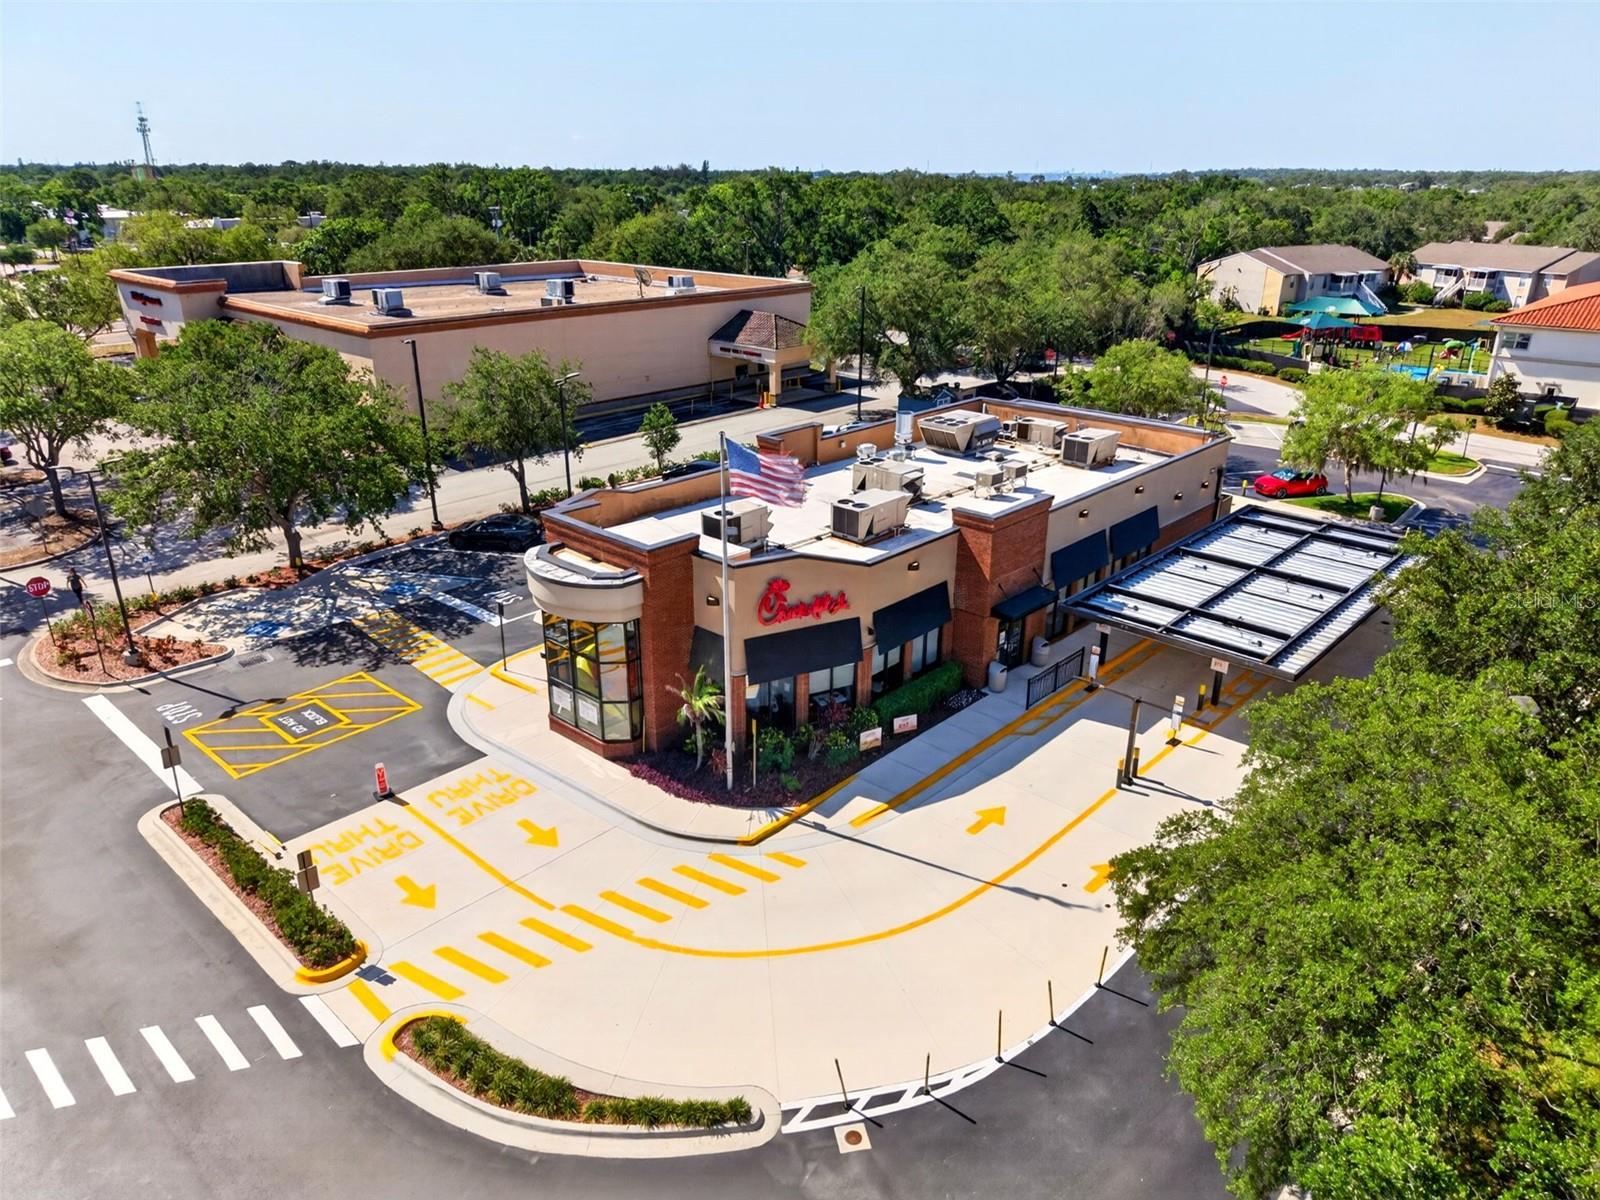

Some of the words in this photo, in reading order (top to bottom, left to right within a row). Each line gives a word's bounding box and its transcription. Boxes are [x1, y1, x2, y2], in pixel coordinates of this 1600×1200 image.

[28, 582, 49, 593] STOP
[156, 701, 202, 724] STOP
[427, 767, 511, 809] THRU
[446, 778, 538, 827] DRIVE
[308, 817, 399, 865] THRU
[320, 831, 424, 886] DRIVE
